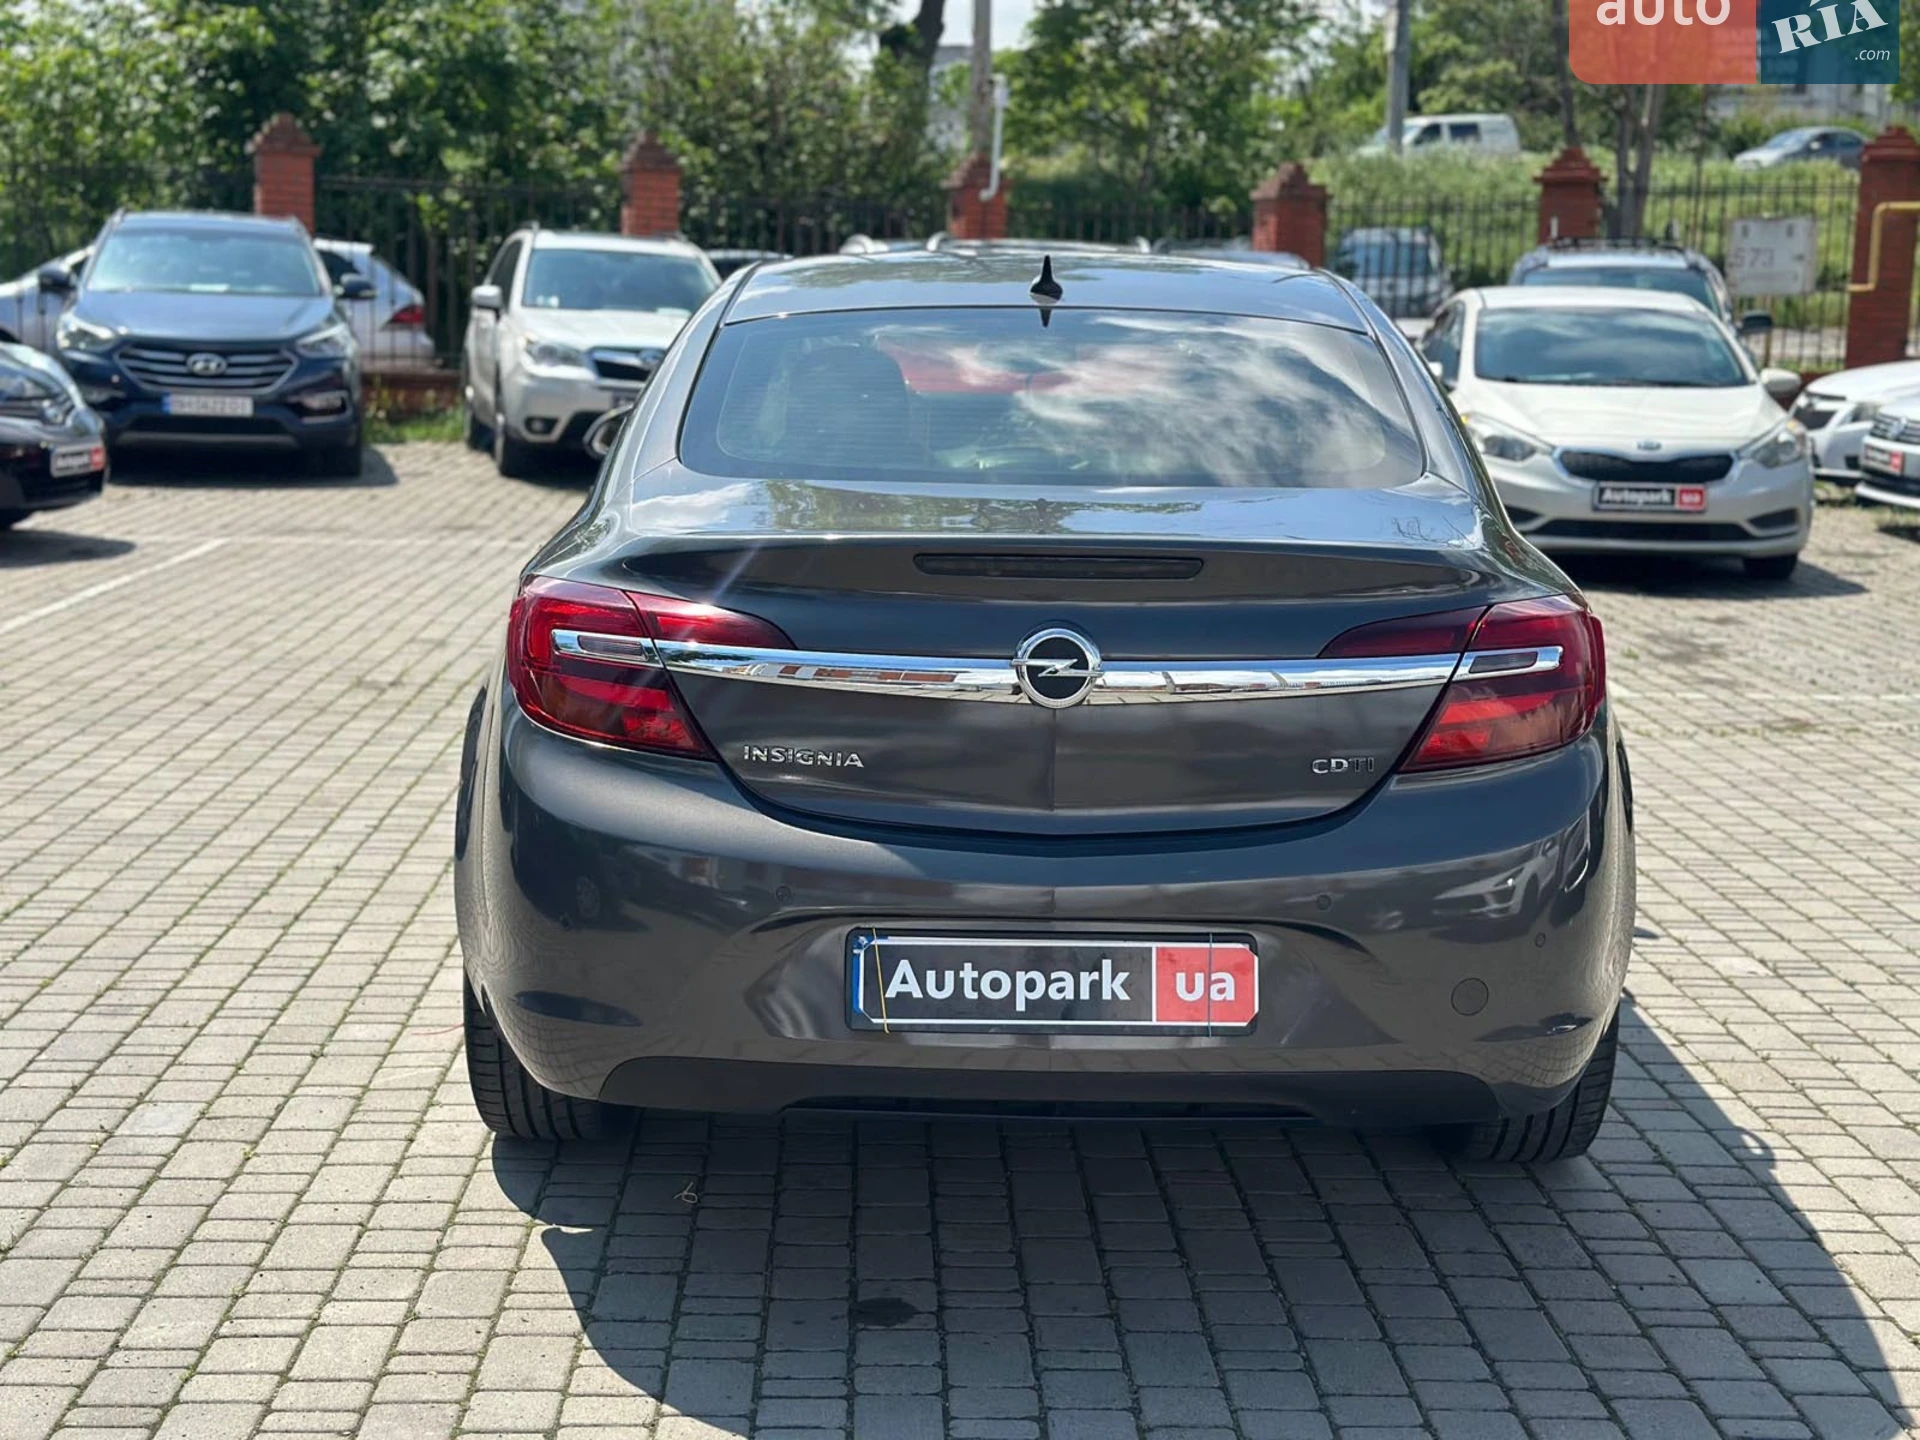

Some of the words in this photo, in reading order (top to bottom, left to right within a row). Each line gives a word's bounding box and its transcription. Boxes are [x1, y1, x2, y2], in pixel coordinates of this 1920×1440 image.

[742, 744, 865, 769] INSIGNIA
[1312, 757, 1375, 774] CDTI
[884, 958, 1131, 1012] Autopark
[1175, 971, 1235, 1001] ua
